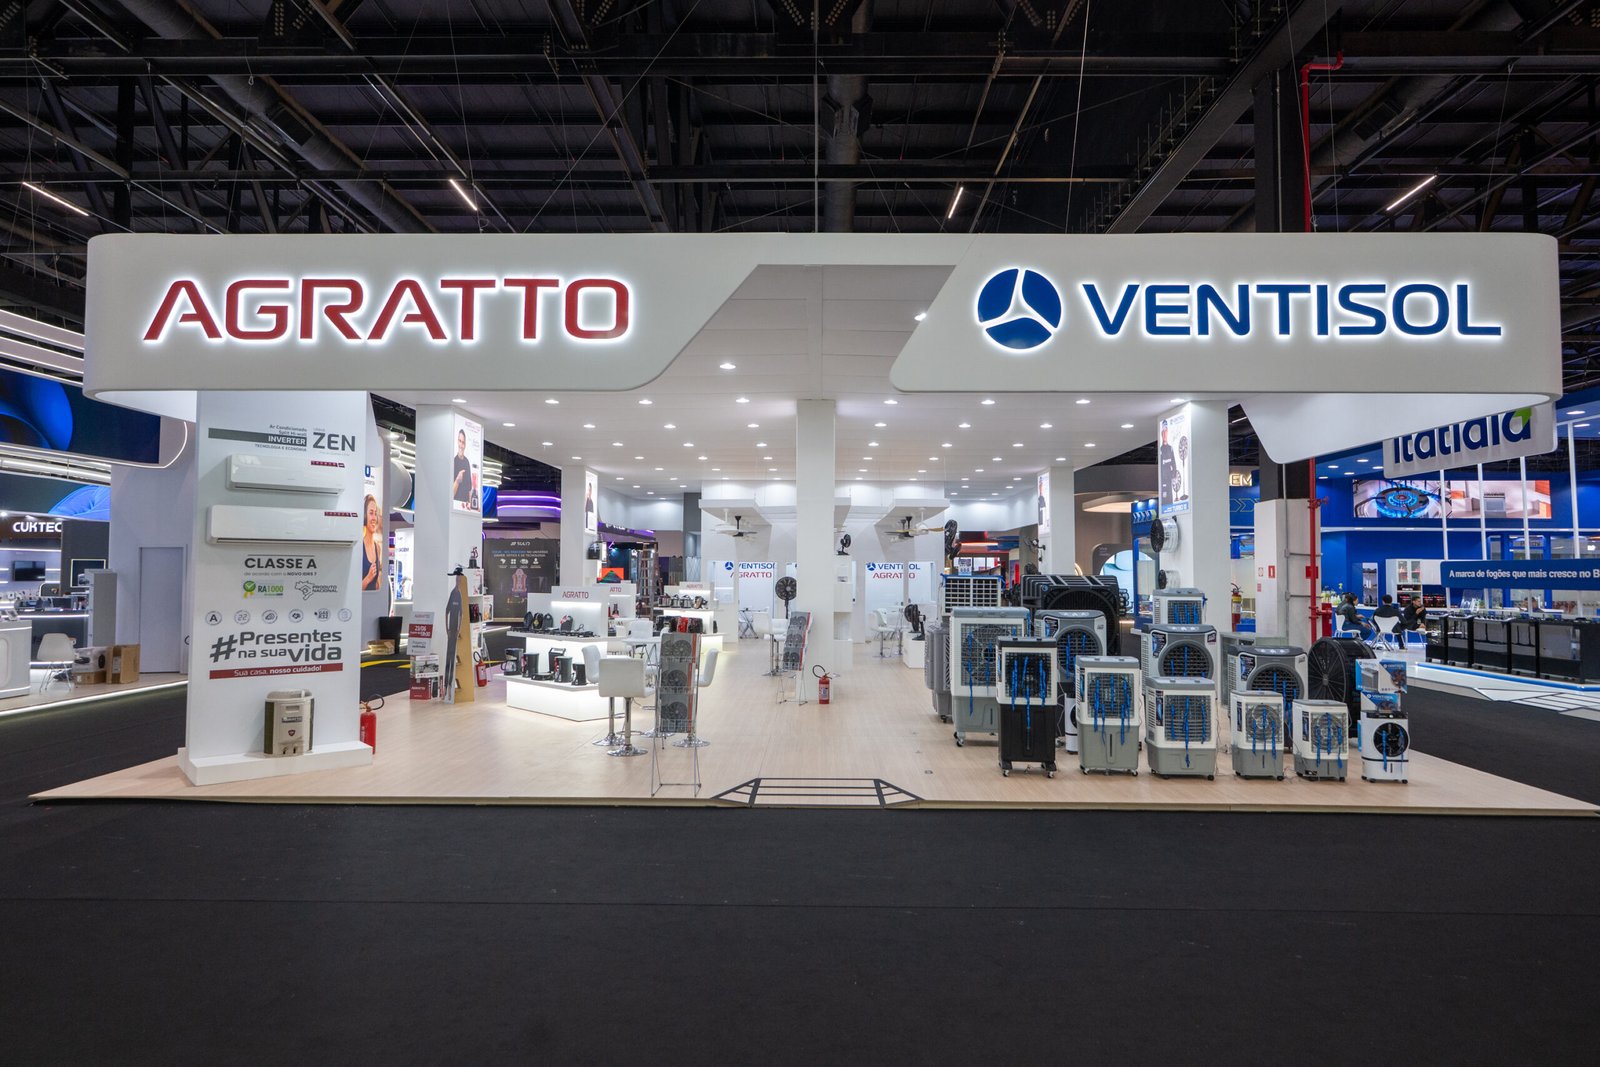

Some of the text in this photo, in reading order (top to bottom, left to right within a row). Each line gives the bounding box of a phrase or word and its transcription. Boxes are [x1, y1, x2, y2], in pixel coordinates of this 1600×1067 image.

[143, 278, 630, 341] AGRATTO
[1082, 283, 1502, 337] VENTISOL
[268, 435, 306, 445] INVERTER
[313, 432, 356, 452] ZEN
[244, 558, 317, 569] CLASSE A
[1449, 569, 1456, 578] A
[1476, 569, 1485, 578] de
[1486, 569, 1511, 580] fogões
[1512, 571, 1527, 580] que
[1528, 569, 1547, 578] mais
[1548, 570, 1577, 578] cresce
[1579, 570, 1591, 578] no
[1592, 568, 1600, 578] B
[257, 585, 284, 593] RA1000
[562, 591, 589, 599] AGRATTO
[238, 643, 342, 662] na sua vida
[234, 669, 249, 677] Sua
[292, 664, 322, 673] cuidado!
